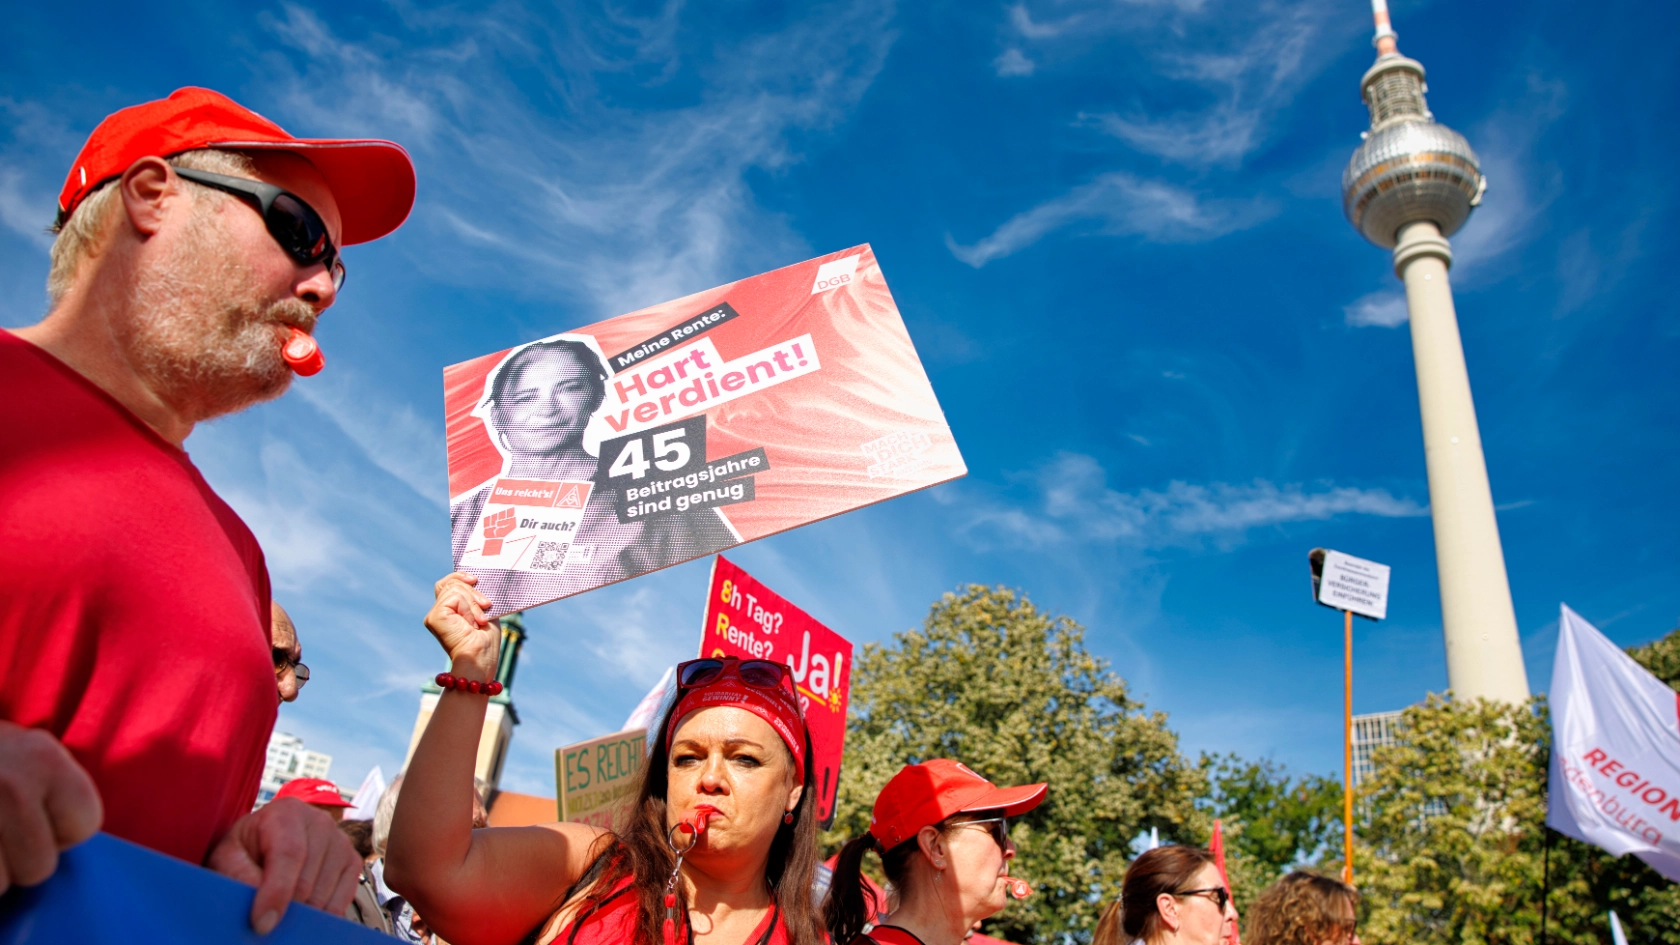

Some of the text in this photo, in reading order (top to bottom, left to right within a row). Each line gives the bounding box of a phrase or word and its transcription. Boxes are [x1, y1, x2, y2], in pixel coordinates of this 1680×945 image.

[817, 273, 851, 290] DGB
[617, 309, 726, 367] Meine Rente:
[604, 342, 809, 433] verdient!
[613, 348, 711, 404] Hart
[608, 427, 691, 480] 45
[626, 456, 761, 501] Beitragsjahre
[495, 487, 554, 500] Uns reicht's!
[627, 483, 744, 518] sind genug
[520, 518, 576, 532] Dir auch?
[720, 579, 784, 635] 8h Tag?
[715, 612, 774, 660] Rente?
[786, 630, 843, 713] Ja!
[566, 747, 591, 793] ES
[1582, 747, 1680, 822] REGION
